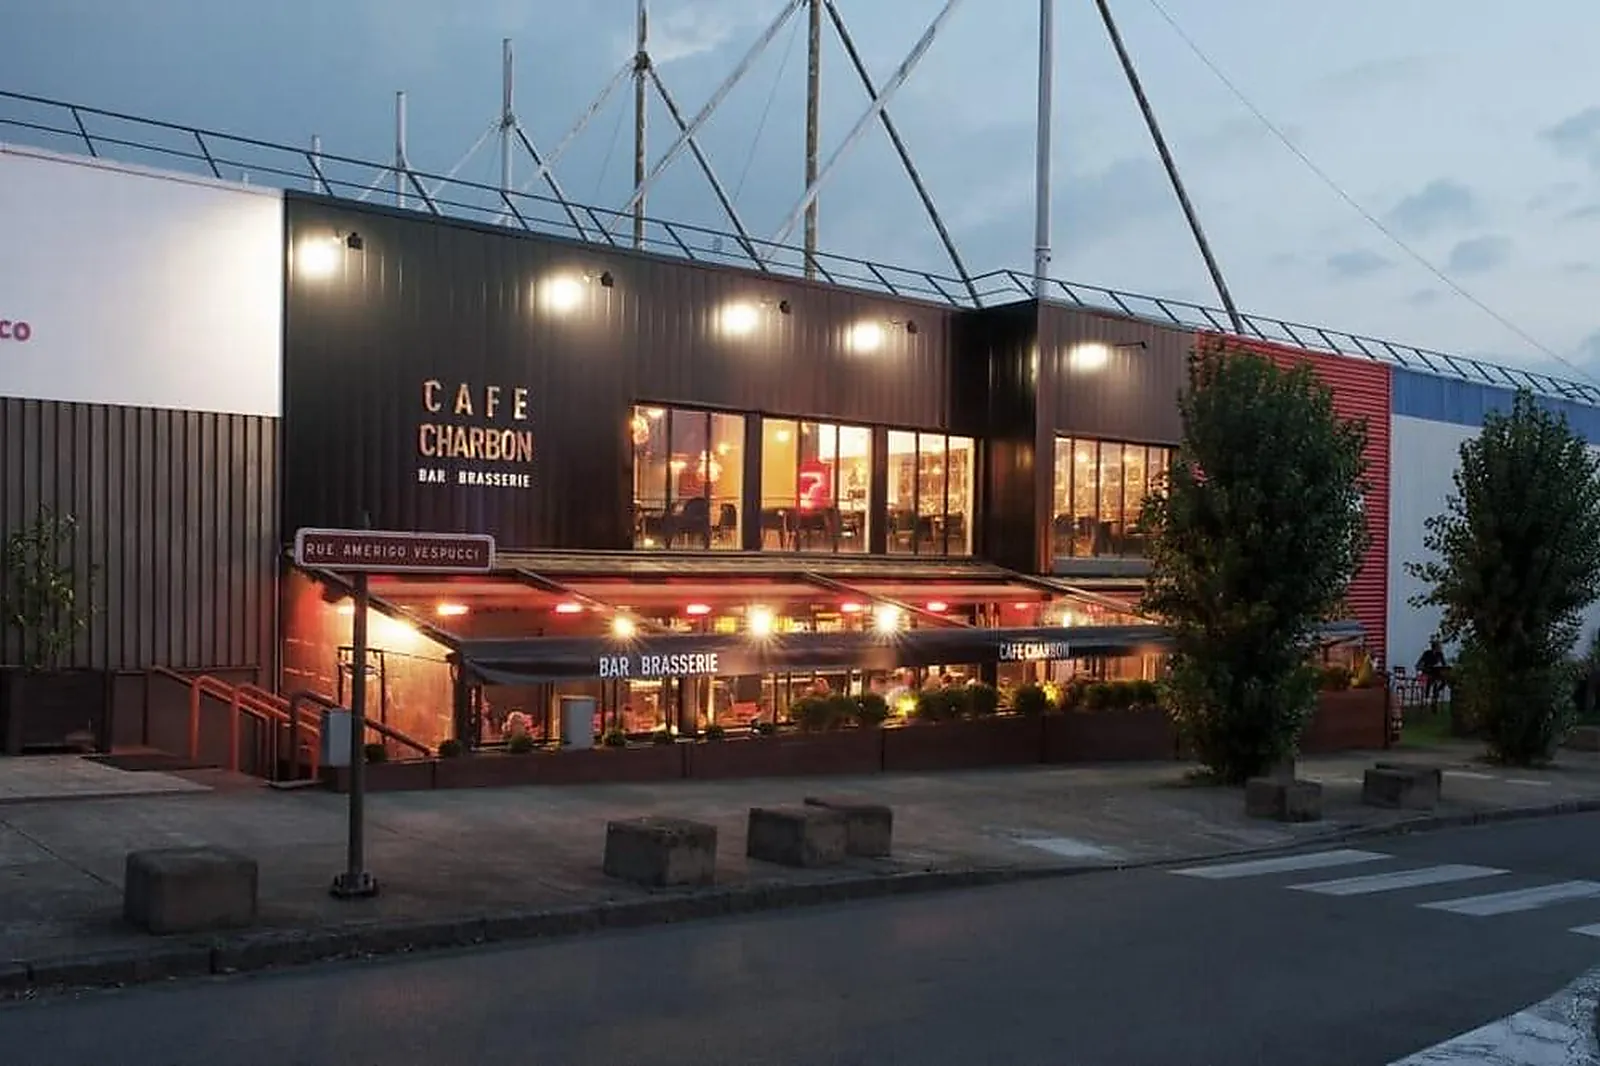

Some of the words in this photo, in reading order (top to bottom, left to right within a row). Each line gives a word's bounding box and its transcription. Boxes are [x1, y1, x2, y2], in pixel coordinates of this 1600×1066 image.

[424, 379, 528, 420] CAFE
[419, 423, 533, 462] CHARBON
[418, 468, 446, 483] BAR
[458, 470, 531, 488] BRASSERIE
[306, 543, 334, 556] RUE
[343, 543, 407, 558] AMERIGO
[414, 546, 480, 560] VESPUCCI
[599, 656, 630, 677] BAR
[641, 653, 718, 675] BRASSERIE
